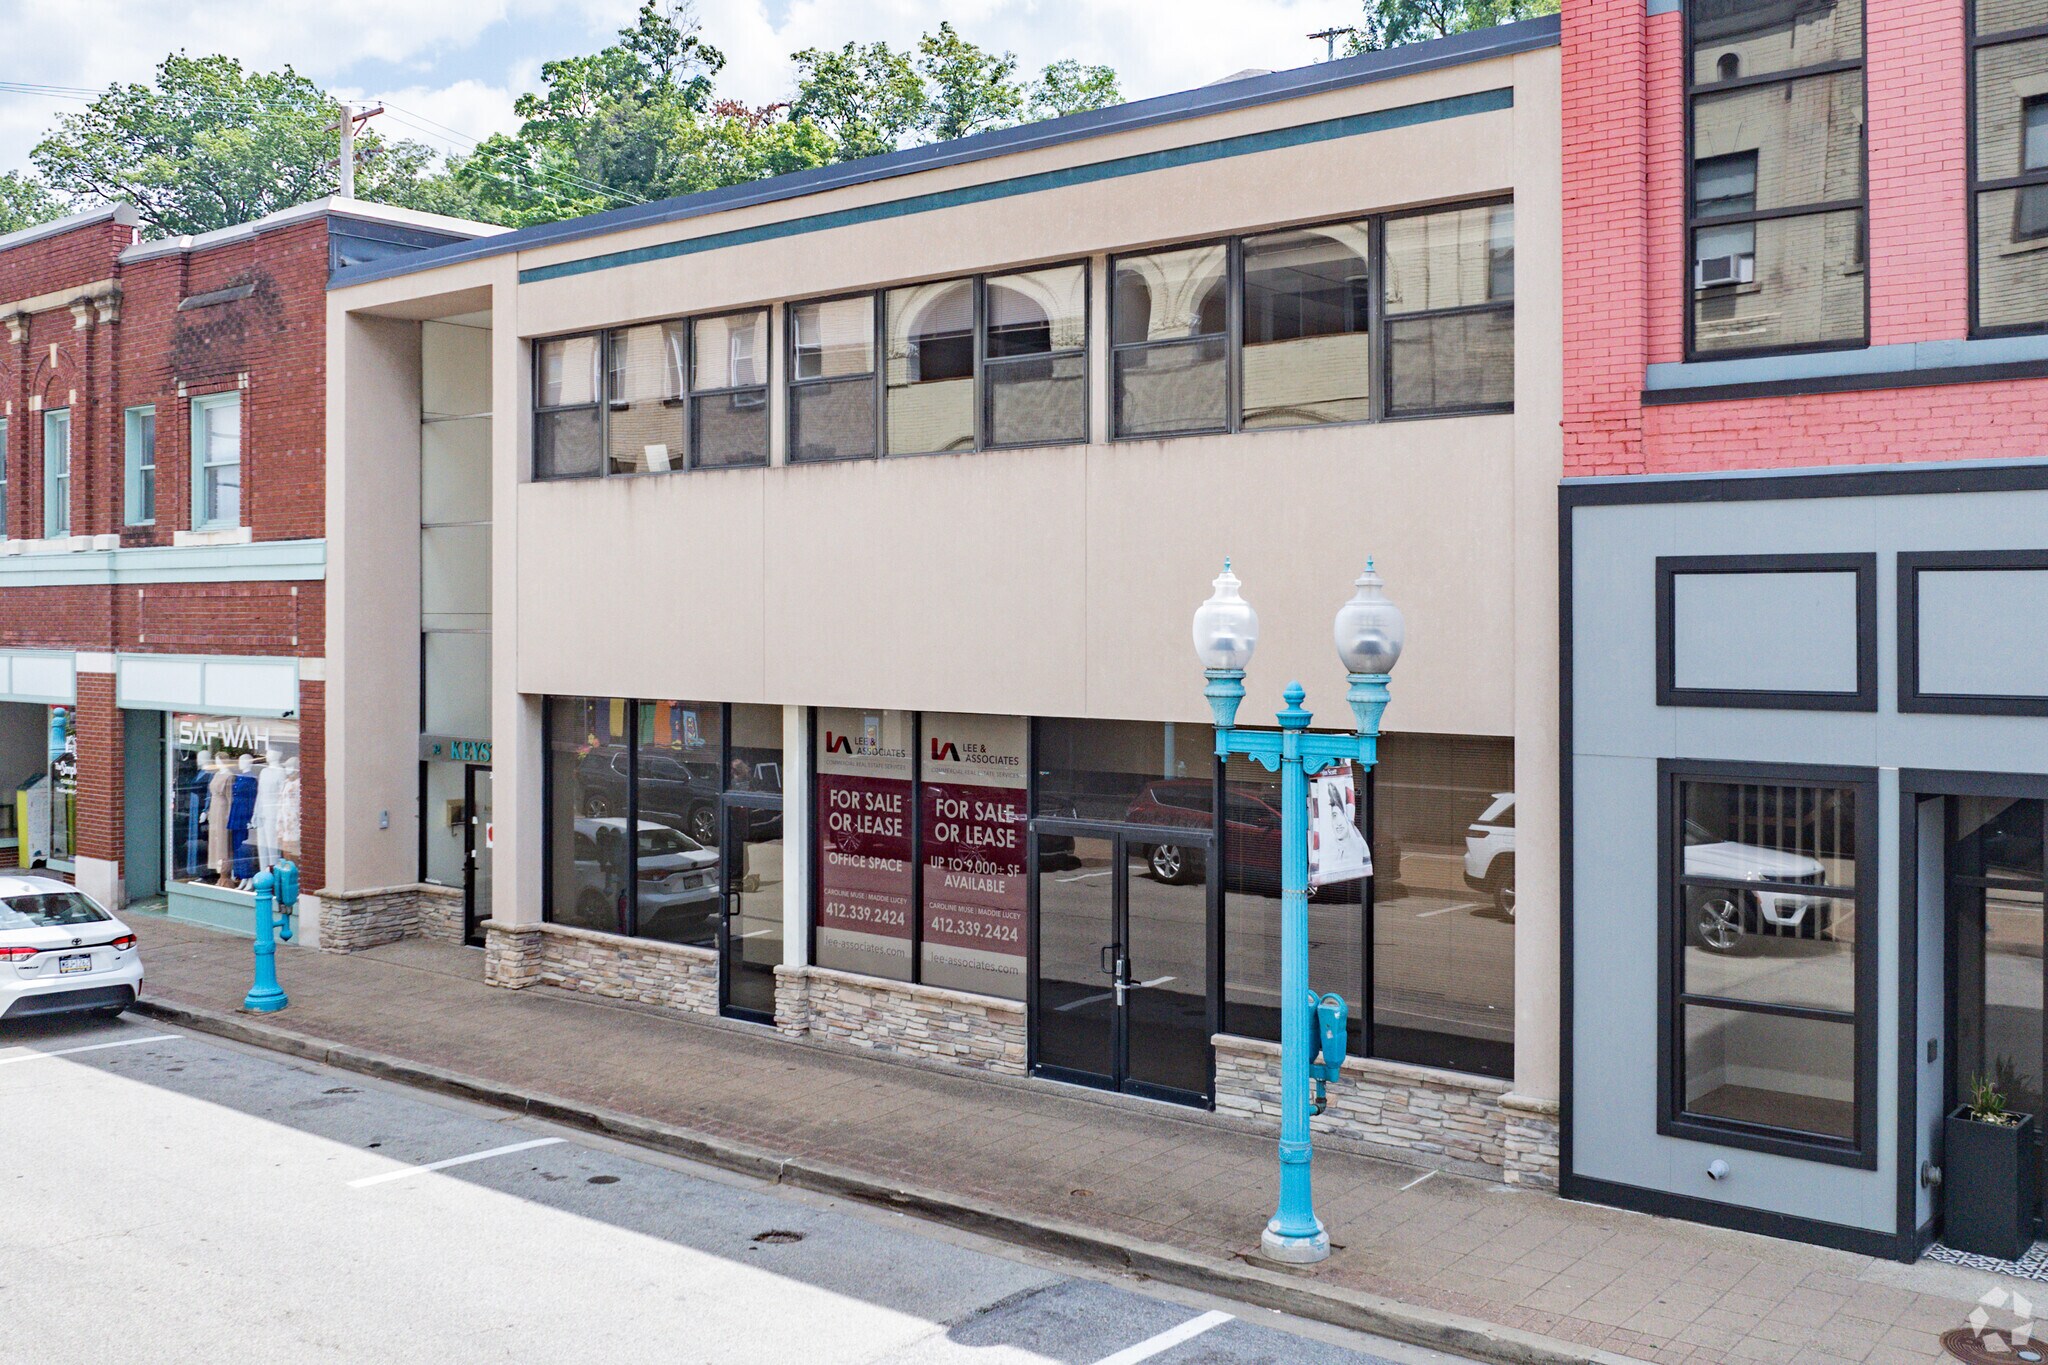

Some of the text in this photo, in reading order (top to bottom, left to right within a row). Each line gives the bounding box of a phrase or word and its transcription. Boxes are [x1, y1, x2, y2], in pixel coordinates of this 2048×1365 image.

[180, 721, 270, 750] SAFWAH
[854, 737, 876, 746] LEE &
[857, 747, 906, 758] ASSOCIATES
[963, 743, 986, 753] LEE &
[965, 754, 1019, 765] ASSOCIATES
[830, 789, 902, 813] FOR SALE
[935, 799, 1015, 823] FOR SALE
[829, 812, 902, 837] OR LEASE
[935, 822, 1015, 848] OR LEASE
[829, 852, 902, 872] OFFICE SPACE
[931, 855, 945, 869] UP
[948, 858, 963, 871] TO
[1007, 864, 1020, 878] SF
[944, 875, 1005, 893] AVAILABLE
[824, 888, 907, 905] CAROLINE MUSE MADDIE LUCEY
[826, 902, 905, 926] 412.339.2424
[929, 901, 1021, 920] CAROLINE MUSE MADDIE LUCEY
[931, 916, 1018, 942] 412.339.2424
[826, 935, 905, 958] lee-associates.com
[930, 951, 1019, 975] lee-associates.com
